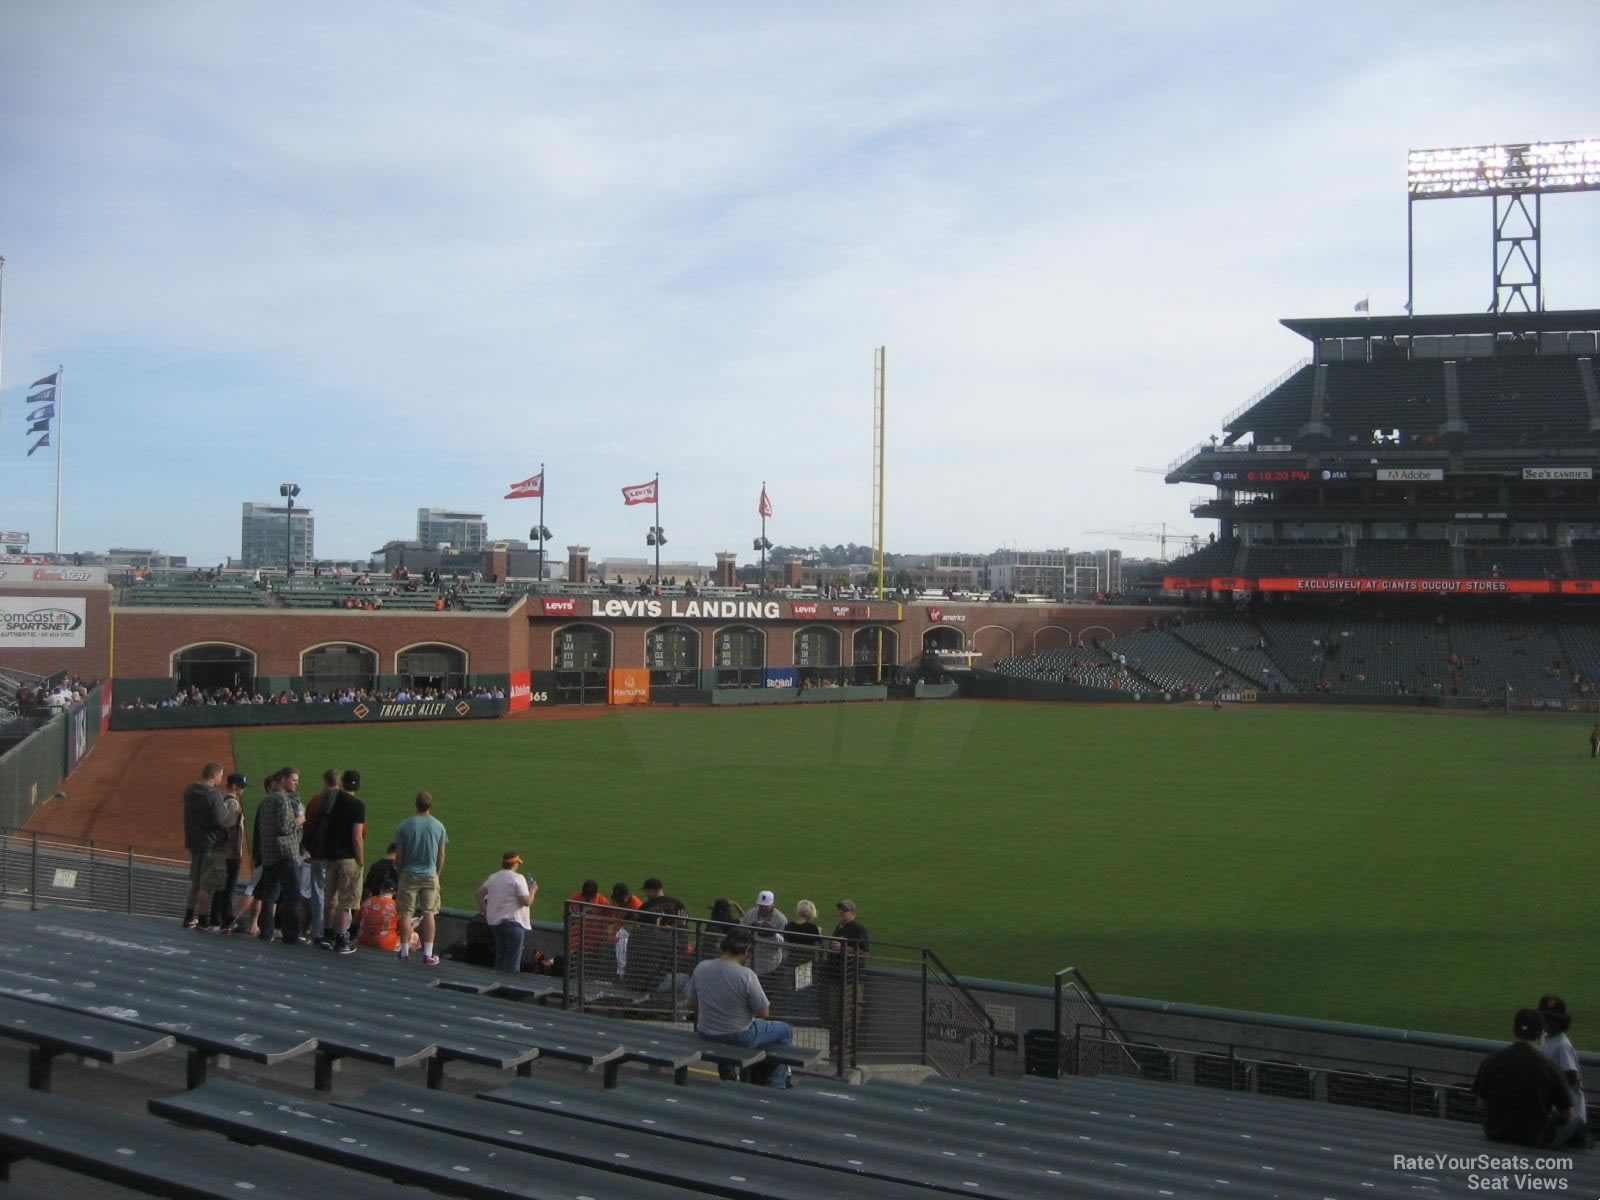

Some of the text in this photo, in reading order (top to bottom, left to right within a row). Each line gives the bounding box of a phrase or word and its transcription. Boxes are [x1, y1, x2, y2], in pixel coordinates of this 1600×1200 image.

[1401, 471, 1431, 480] Adobe
[1297, 580, 1362, 589] EXCLUSIVELY
[1365, 580, 1379, 589] AT
[671, 601, 780, 619] LANDING
[941, 614, 966, 622] america
[6, 622, 71, 631] SPORTSNET
[380, 703, 415, 717] TRIPLES
[418, 702, 446, 716] ALLEY
